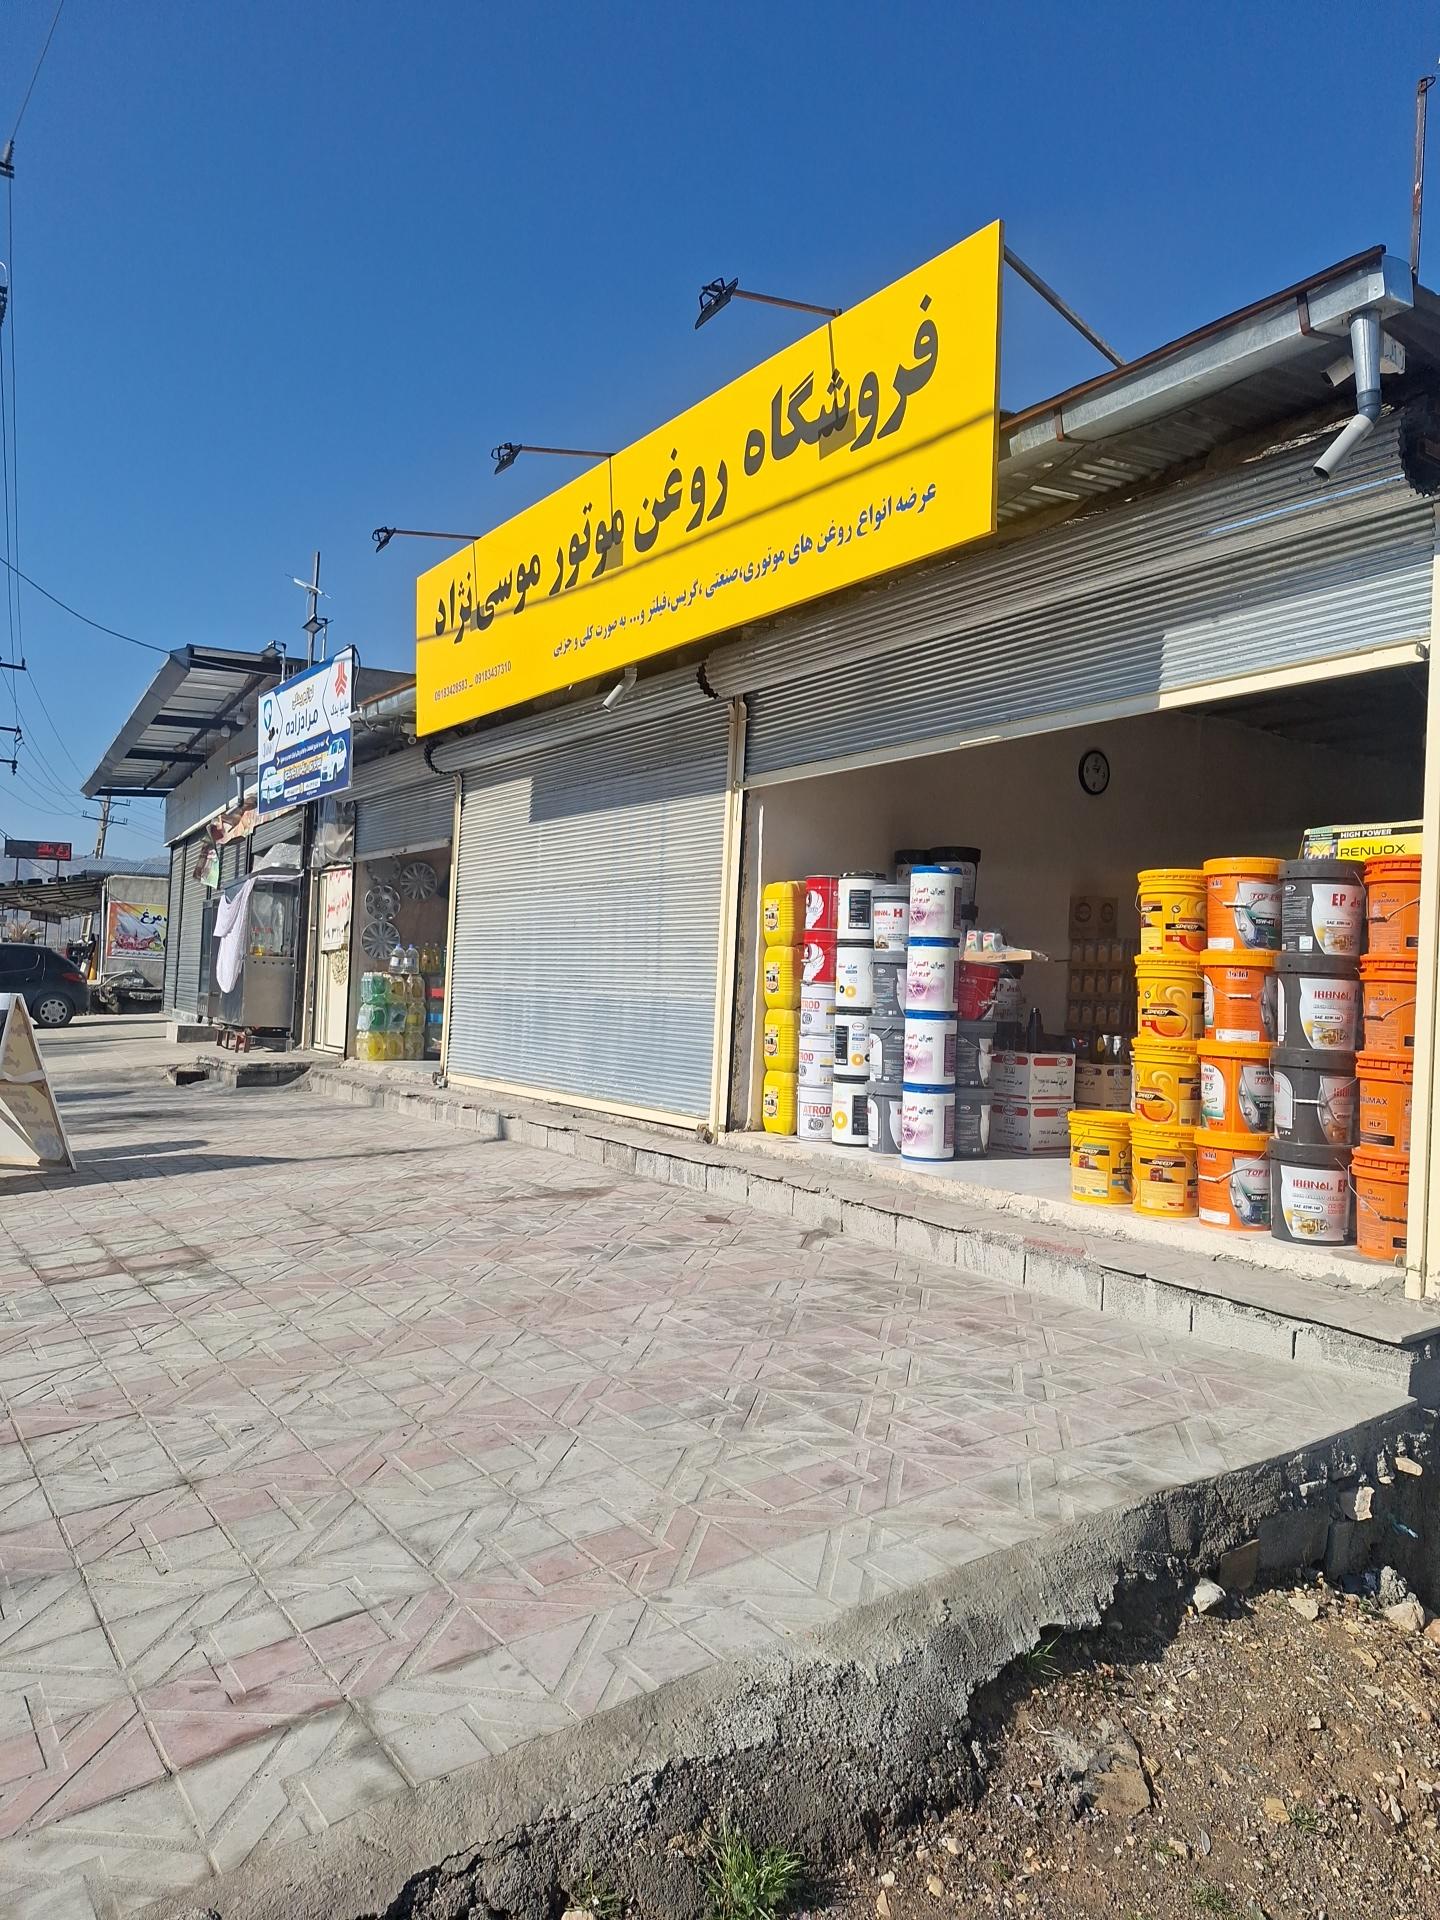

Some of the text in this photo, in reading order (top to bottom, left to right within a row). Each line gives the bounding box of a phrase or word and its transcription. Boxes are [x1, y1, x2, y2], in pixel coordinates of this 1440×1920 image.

[743, 294, 939, 477] فروشگاه
[634, 447, 728, 553] روغن
[896, 483, 937, 514] عرضه
[856, 495, 892, 538] انواع
[549, 502, 625, 597] موتور
[788, 532, 813, 566] های
[816, 519, 853, 553] روغن
[595, 619, 618, 640] صورت
[285, 708, 319, 737] مرادزاده
[1340, 830, 1361, 839] HIGH
[1361, 828, 1393, 838] POWER
[1340, 843, 1406, 857] RENUOX
[1331, 893, 1347, 908] EP
[140, 908, 162, 925] مرغ
[1369, 1120, 1382, 1128] HLP
